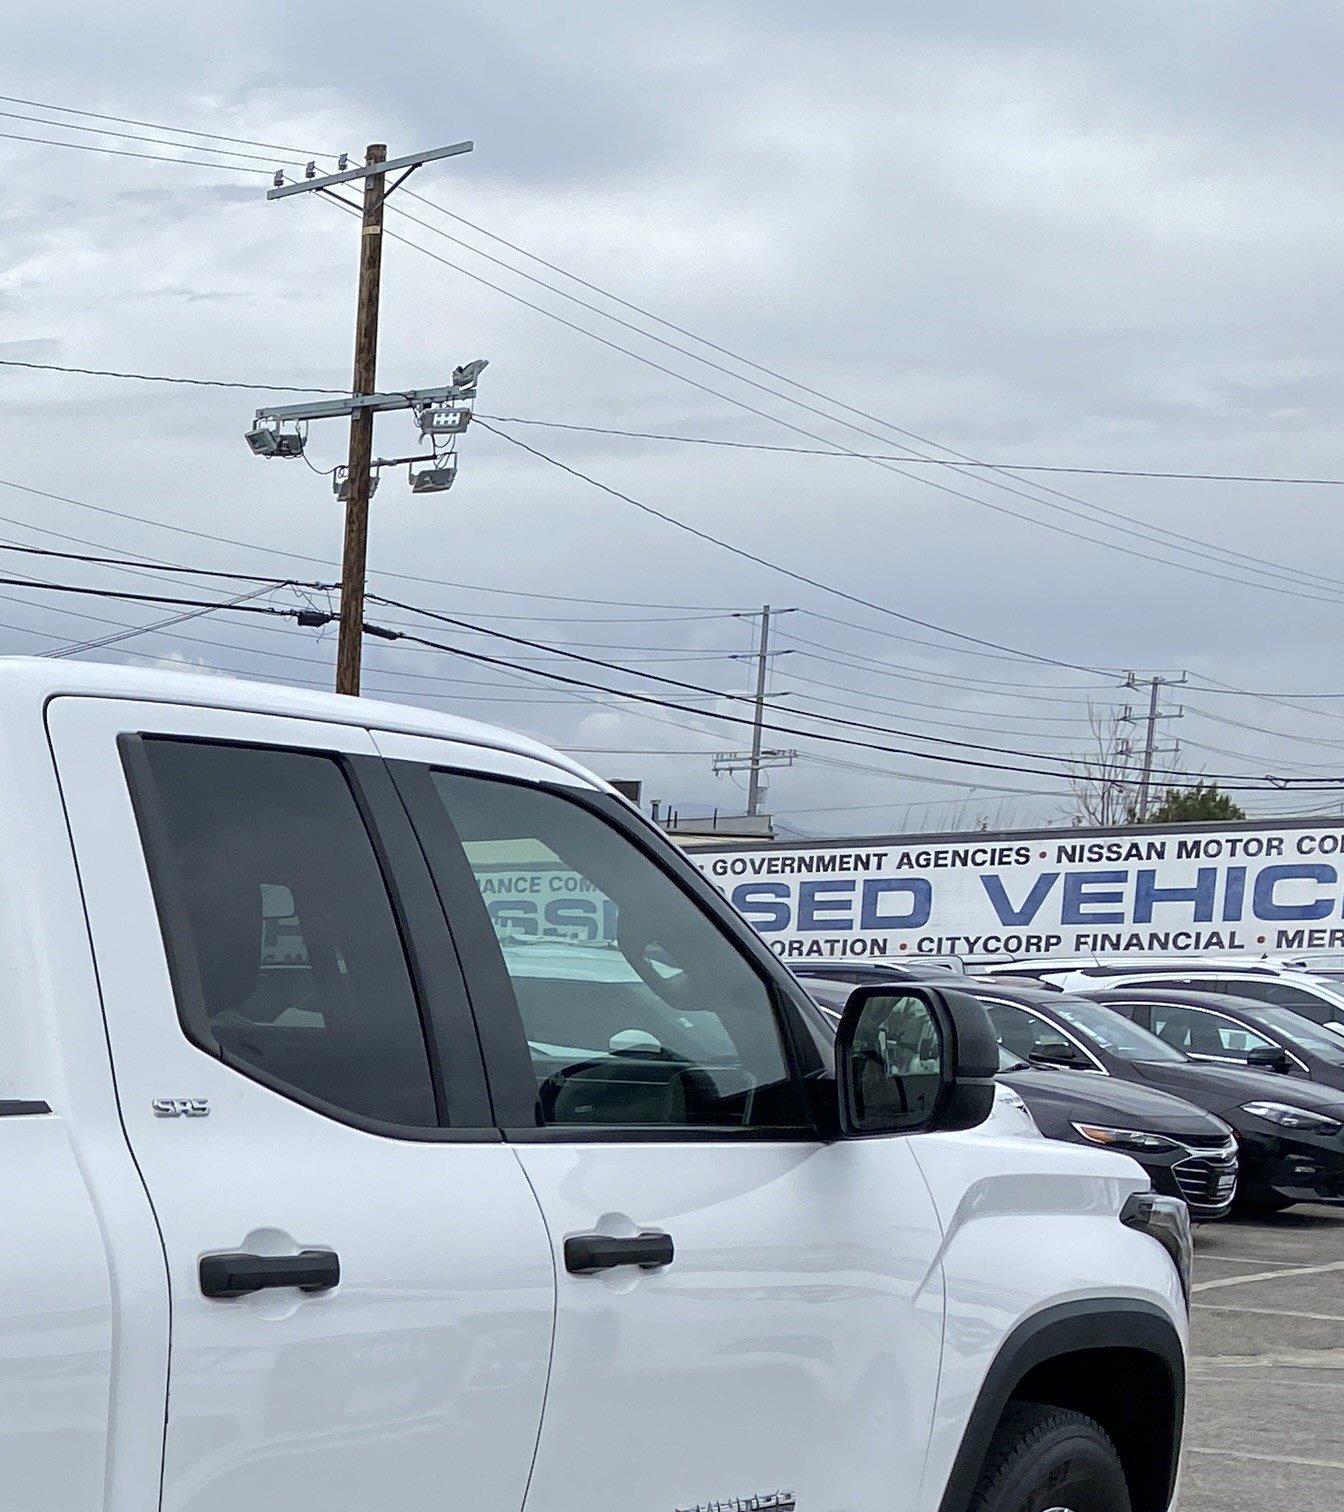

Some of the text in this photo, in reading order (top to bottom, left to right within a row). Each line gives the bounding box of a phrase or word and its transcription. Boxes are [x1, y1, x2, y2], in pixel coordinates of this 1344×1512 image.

[711, 833, 1344, 876] GOVERNMENT AGENCIES NISSAN MOTOR CO
[477, 875, 543, 894] ANCE
[716, 863, 1344, 933] SED VEHIC
[916, 933, 1062, 956] CITYCORP
[1074, 930, 1246, 952] FINANCIAL
